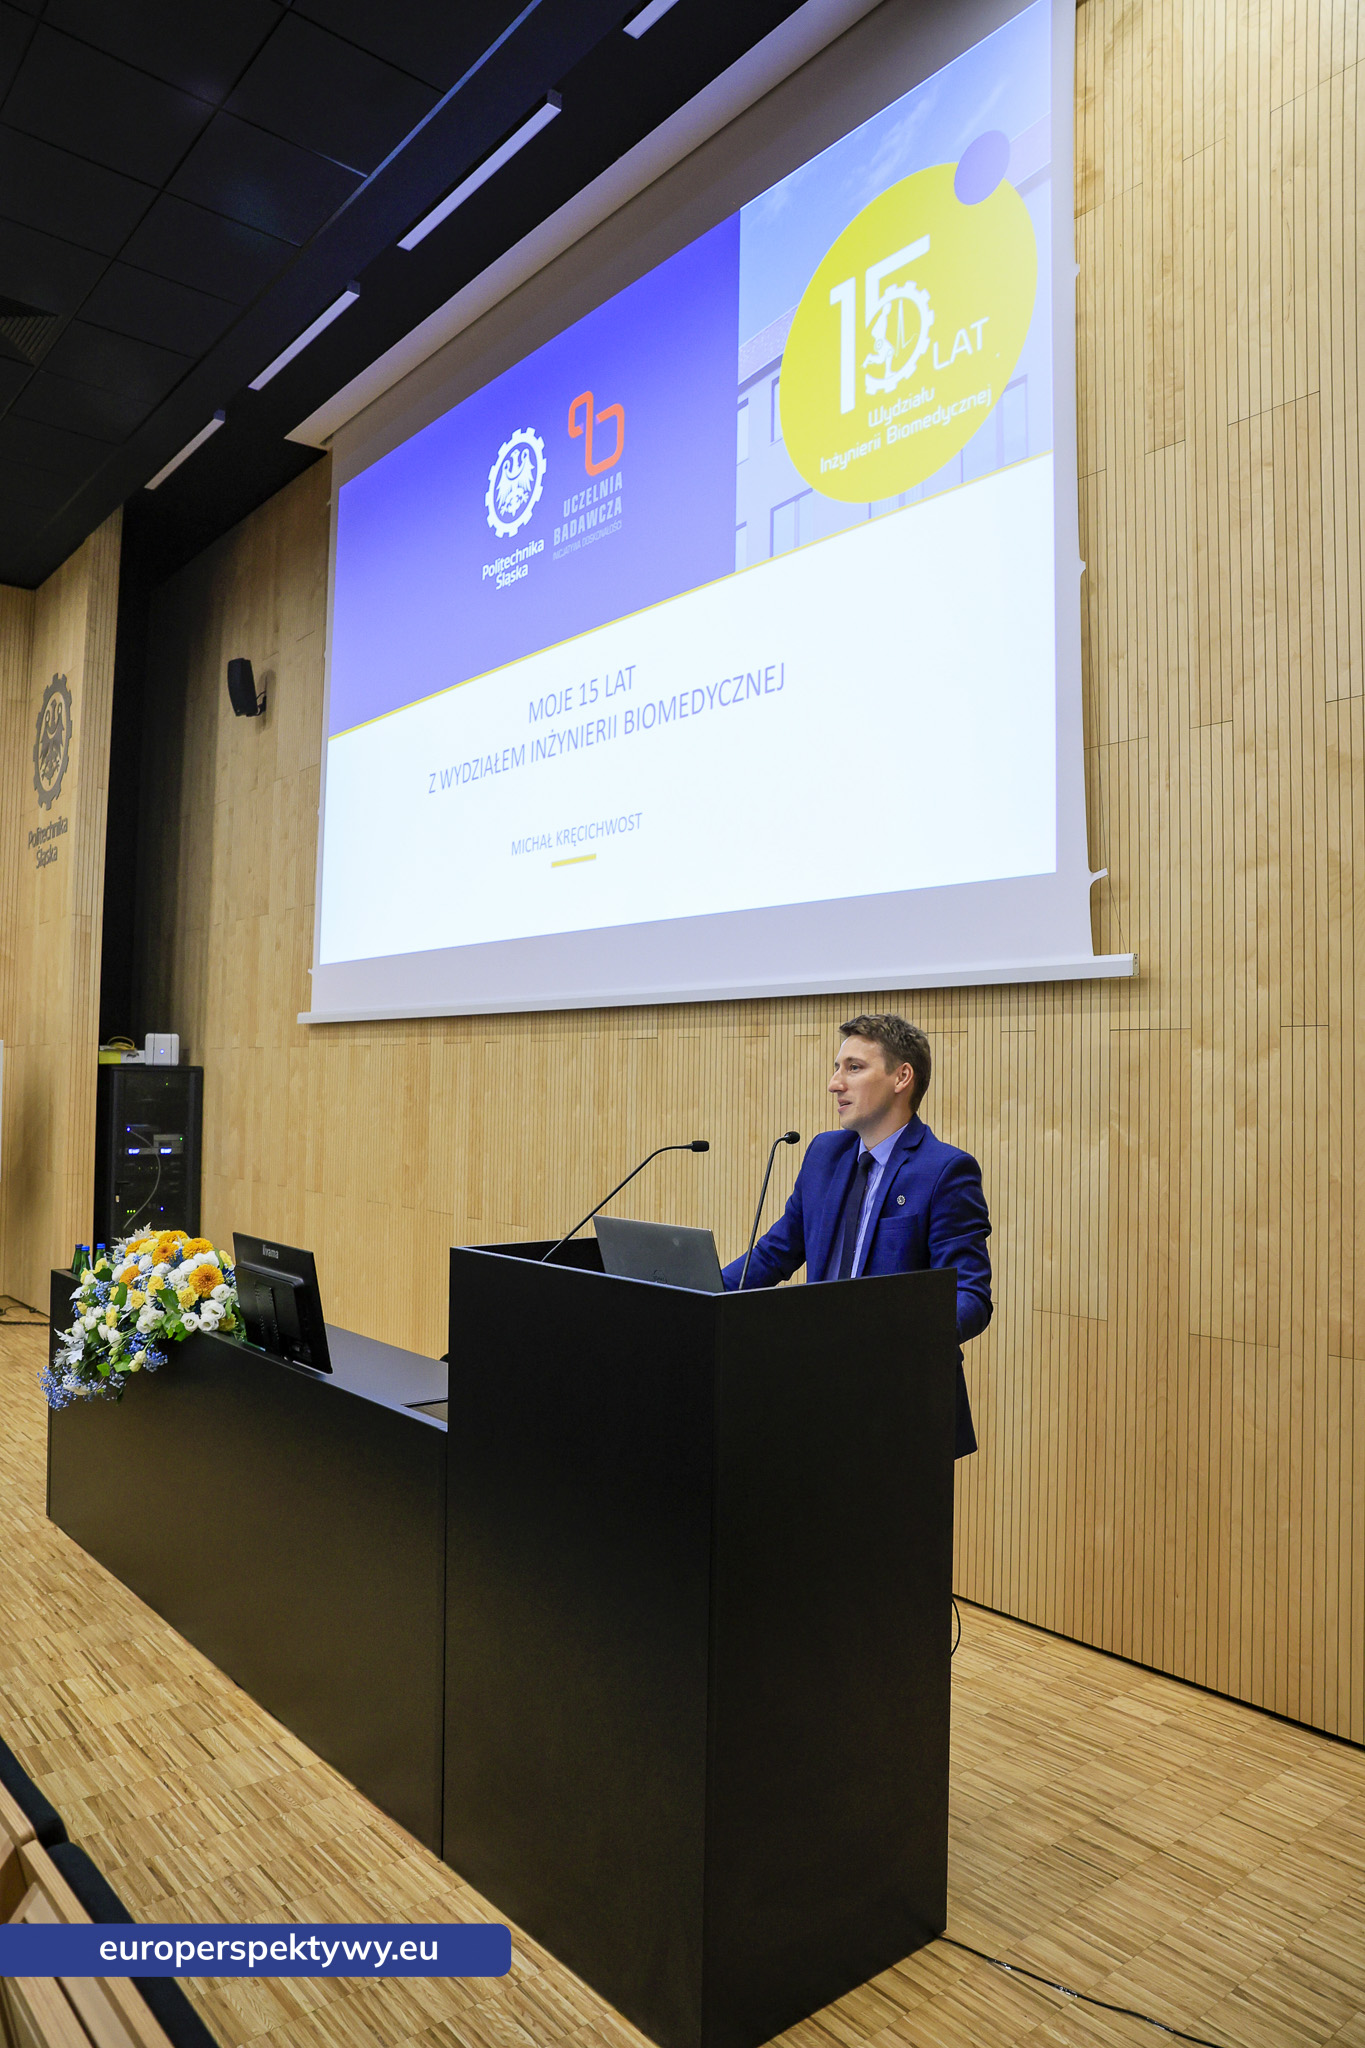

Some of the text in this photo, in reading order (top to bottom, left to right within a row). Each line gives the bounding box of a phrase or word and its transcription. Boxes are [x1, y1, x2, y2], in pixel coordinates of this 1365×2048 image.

[829, 233, 935, 415] 15
[932, 316, 990, 371] LAT
[819, 384, 993, 474] Inżynierii Biomedycznej
[868, 386, 935, 428] Wydziału
[563, 471, 623, 518] UCZELNIA
[553, 496, 623, 546] BADAWCZA
[482, 539, 545, 580] Politechnika
[495, 564, 529, 590] Śląska
[528, 665, 637, 724] MOJE 15 LAT
[428, 662, 786, 794] Z WYDZIAŁEM INŻYNIERII BIOMEDYCZNEJ
[28, 815, 68, 850] Politechnika
[511, 812, 643, 856] MICHAŁ KRĘCICHWOST
